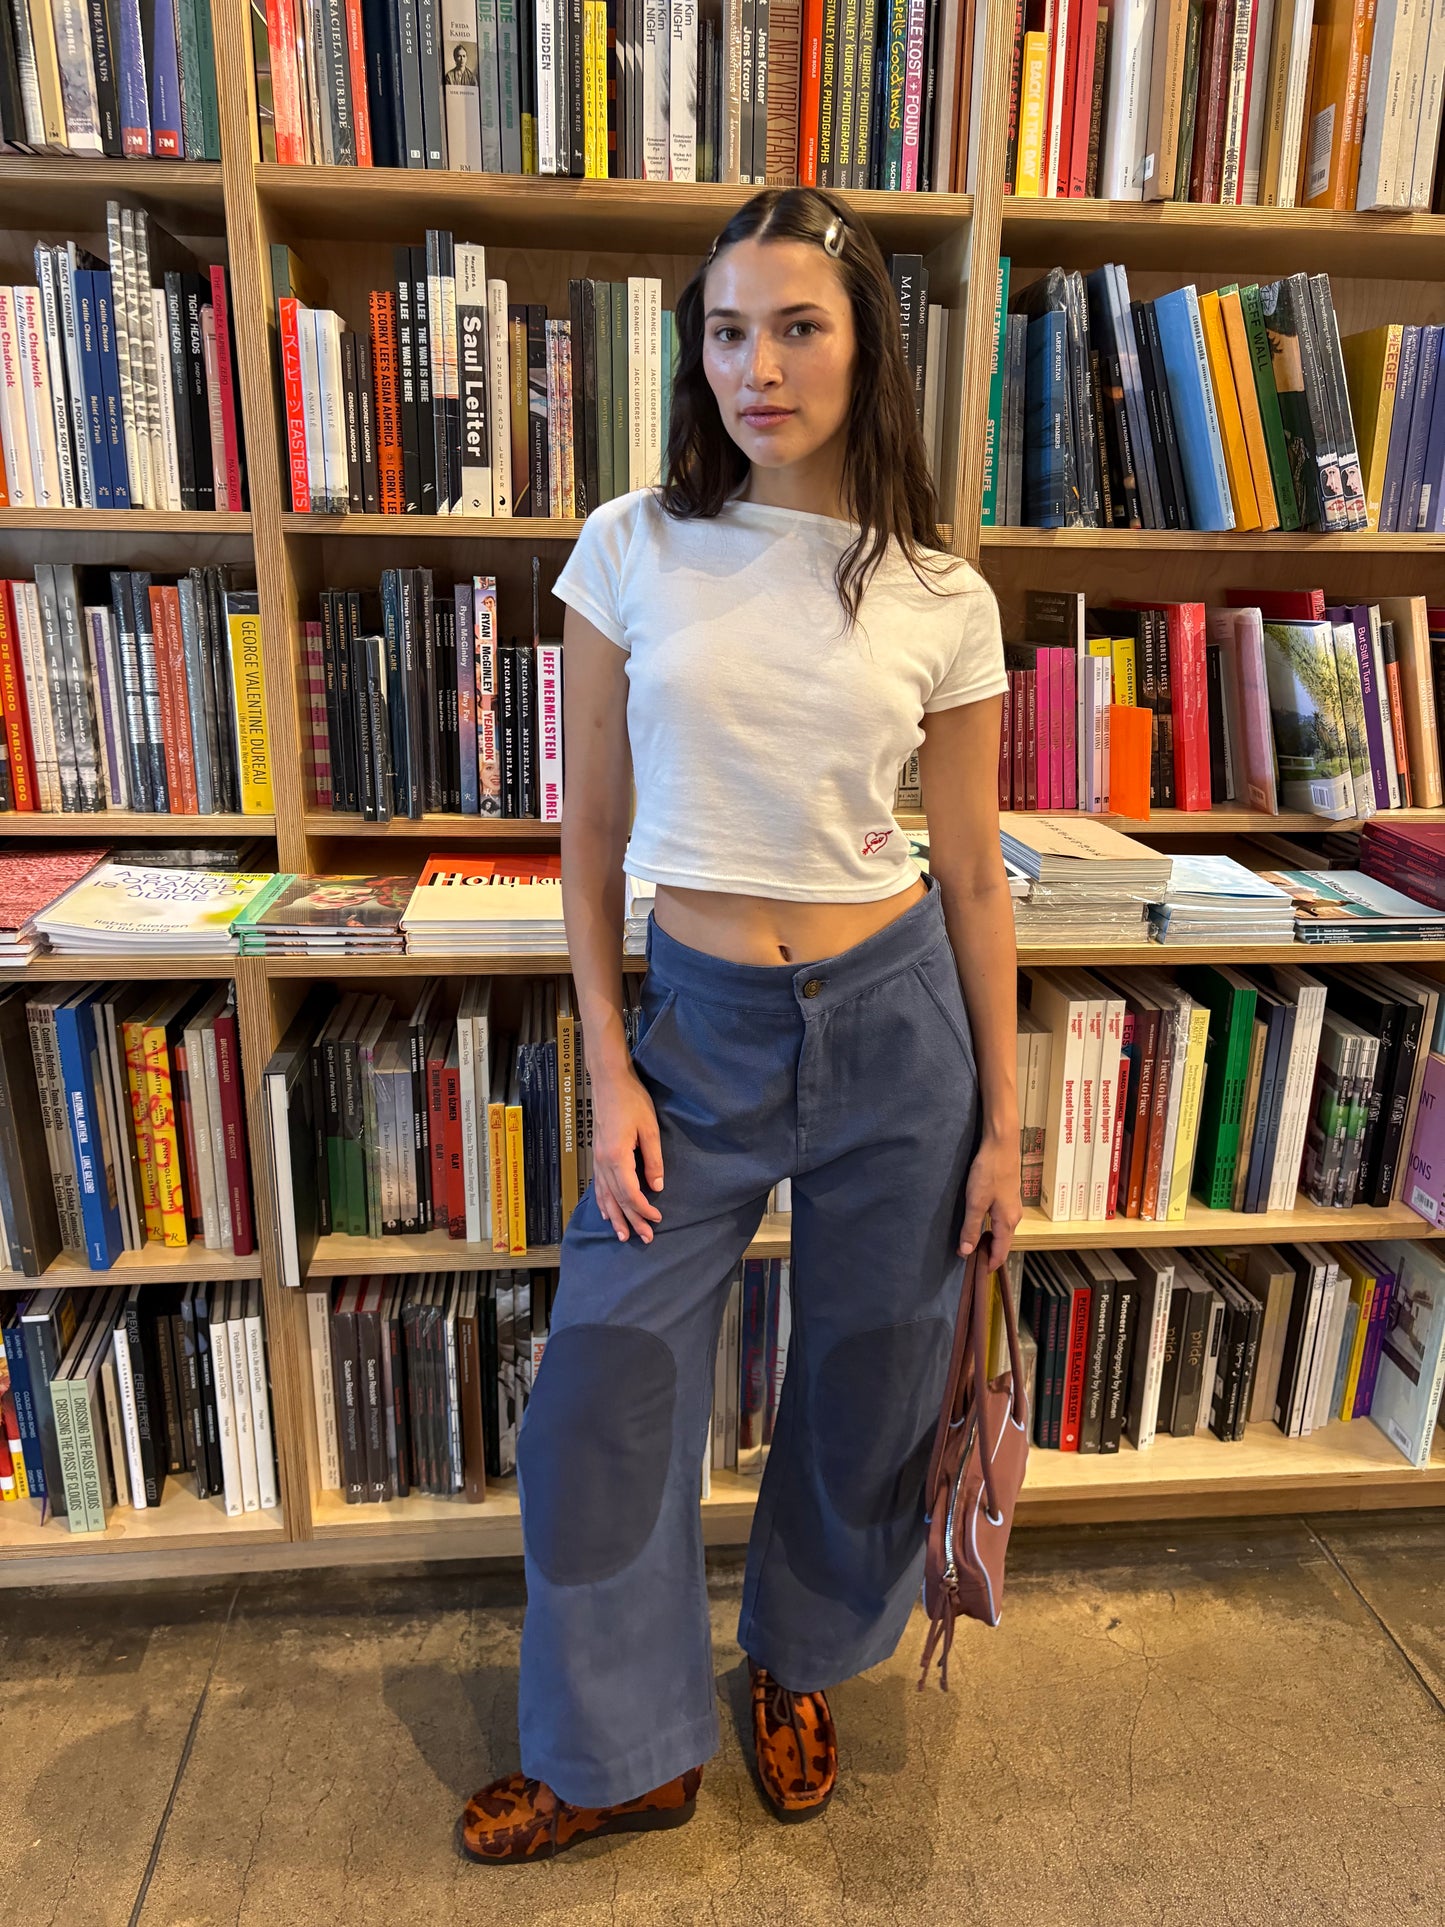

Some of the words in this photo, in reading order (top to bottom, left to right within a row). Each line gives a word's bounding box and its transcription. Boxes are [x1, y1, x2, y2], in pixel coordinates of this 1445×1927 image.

[314, 9, 323, 50] PORTRAITS
[330, 0, 342, 59] RACIELA
[450, 30, 470, 38] KAHLO
[774, 6, 799, 35] THE
[825, 0, 836, 40] STANLEY
[892, 0, 906, 38] apelle
[66, 29, 76, 55] BIBEL
[92, 3, 108, 82] DREAMLANDS
[541, 23, 551, 71] HIDDEN
[743, 26, 752, 52] Jens
[769, 39, 798, 77] NEW
[824, 43, 834, 87] KUBRICK
[889, 42, 905, 86] Good
[907, 40, 922, 80] LOST
[742, 57, 750, 103] Krauer
[1026, 60, 1042, 99] BACK
[767, 81, 798, 124] YORK
[888, 88, 903, 129] News
[1026, 101, 1038, 117] IN
[821, 90, 833, 164] PHOTOGRAPHS
[905, 96, 919, 146] FOUND
[1025, 119, 1039, 147] THE
[767, 124, 796, 175] YEARS
[1023, 149, 1037, 178] DAY
[42, 258, 50, 282] TRACY
[46, 292, 56, 337] CHANDLER
[399, 281, 407, 300] BUD
[25, 296, 36, 329] Helen
[400, 302, 408, 320] LEE
[378, 313, 388, 345] CORKY
[401, 327, 409, 344] THE
[380, 347, 389, 371] LEE'S
[402, 346, 410, 365] WAR
[463, 316, 482, 373] Saul
[1254, 330, 1267, 371] WALL
[28, 332, 40, 388] Chadwick
[403, 368, 411, 376] IS
[1383, 333, 1401, 391] WEEGEE
[116, 330, 136, 430] CLARK
[382, 374, 391, 404] ASIAN
[404, 378, 413, 403] HERE
[57, 406, 66, 430] POOR
[384, 406, 394, 447] AMERICA
[465, 380, 485, 457] Leiter
[60, 432, 68, 452] SORT
[62, 455, 69, 465] OF
[291, 419, 308, 508] EASTBEATS
[64, 468, 74, 505] MEMORY
[481, 613, 491, 638] RYAN
[1358, 627, 1366, 642] But
[1, 643, 9, 660] DE
[242, 621, 258, 668] GEORGE
[460, 629, 468, 667] McGinley
[1360, 644, 1368, 661] Still
[481, 646, 493, 694] McGINLEY
[543, 651, 555, 675] JEFF
[3, 664, 15, 711] MÉXICO
[1363, 669, 1371, 694] Turns
[246, 671, 263, 735] VALENTINE
[359, 692, 368, 752] DESCENDANTS
[543, 679, 556, 760] MERMELSTEIN
[11, 723, 22, 762] PABLO
[483, 713, 494, 761] YEARBOOK
[250, 738, 267, 785] DUREAU
[909, 755, 917, 782] WORLD
[15, 766, 27, 801] DIEGO
[545, 783, 557, 819] MÖREL
[122, 878, 238, 889] ORANGE
[143, 873, 254, 884] GOLDEN
[153, 886, 209, 895] SUN
[428, 872, 520, 887] Holy
[128, 892, 209, 901] JUICE
[151, 1041, 159, 1065] PATTI
[154, 1068, 162, 1094] SMITH
[564, 1063, 570, 1074] 54
[1162, 1059, 1172, 1079] Face
[447, 1078, 455, 1095] EMIN
[1066, 1080, 1075, 1106] Dressed
[1160, 1082, 1167, 1093] to
[74, 1091, 84, 1118] NATIONAL
[448, 1097, 457, 1121] ÖZMEN
[1156, 1094, 1167, 1117] Face
[78, 1120, 88, 1143] ANTHEM
[564, 1096, 572, 1152] PAPAGEORGE
[1065, 1116, 1073, 1144] Impress
[82, 1156, 91, 1169] LUKE
[451, 1153, 459, 1169] OLAY
[85, 1171, 95, 1194] GILFORD
[164, 1161, 173, 1210] GOLDSMITH
[126, 1310, 139, 1343] PLEXUS
[1074, 1297, 1087, 1350] PICTURING
[1120, 1294, 1131, 1332] Pioneers
[1113, 1333, 1126, 1379] Photography
[1189, 1331, 1201, 1366] pride
[1071, 1352, 1084, 1382] BLACK
[1112, 1381, 1121, 1390] by
[56, 1398, 70, 1435] CROSSING
[1067, 1386, 1081, 1424] HISTORY
[1110, 1391, 1121, 1420] Women
[61, 1436, 71, 1452] THE
[64, 1453, 75, 1472] PASS
[68, 1483, 82, 1511] CLOUDS
